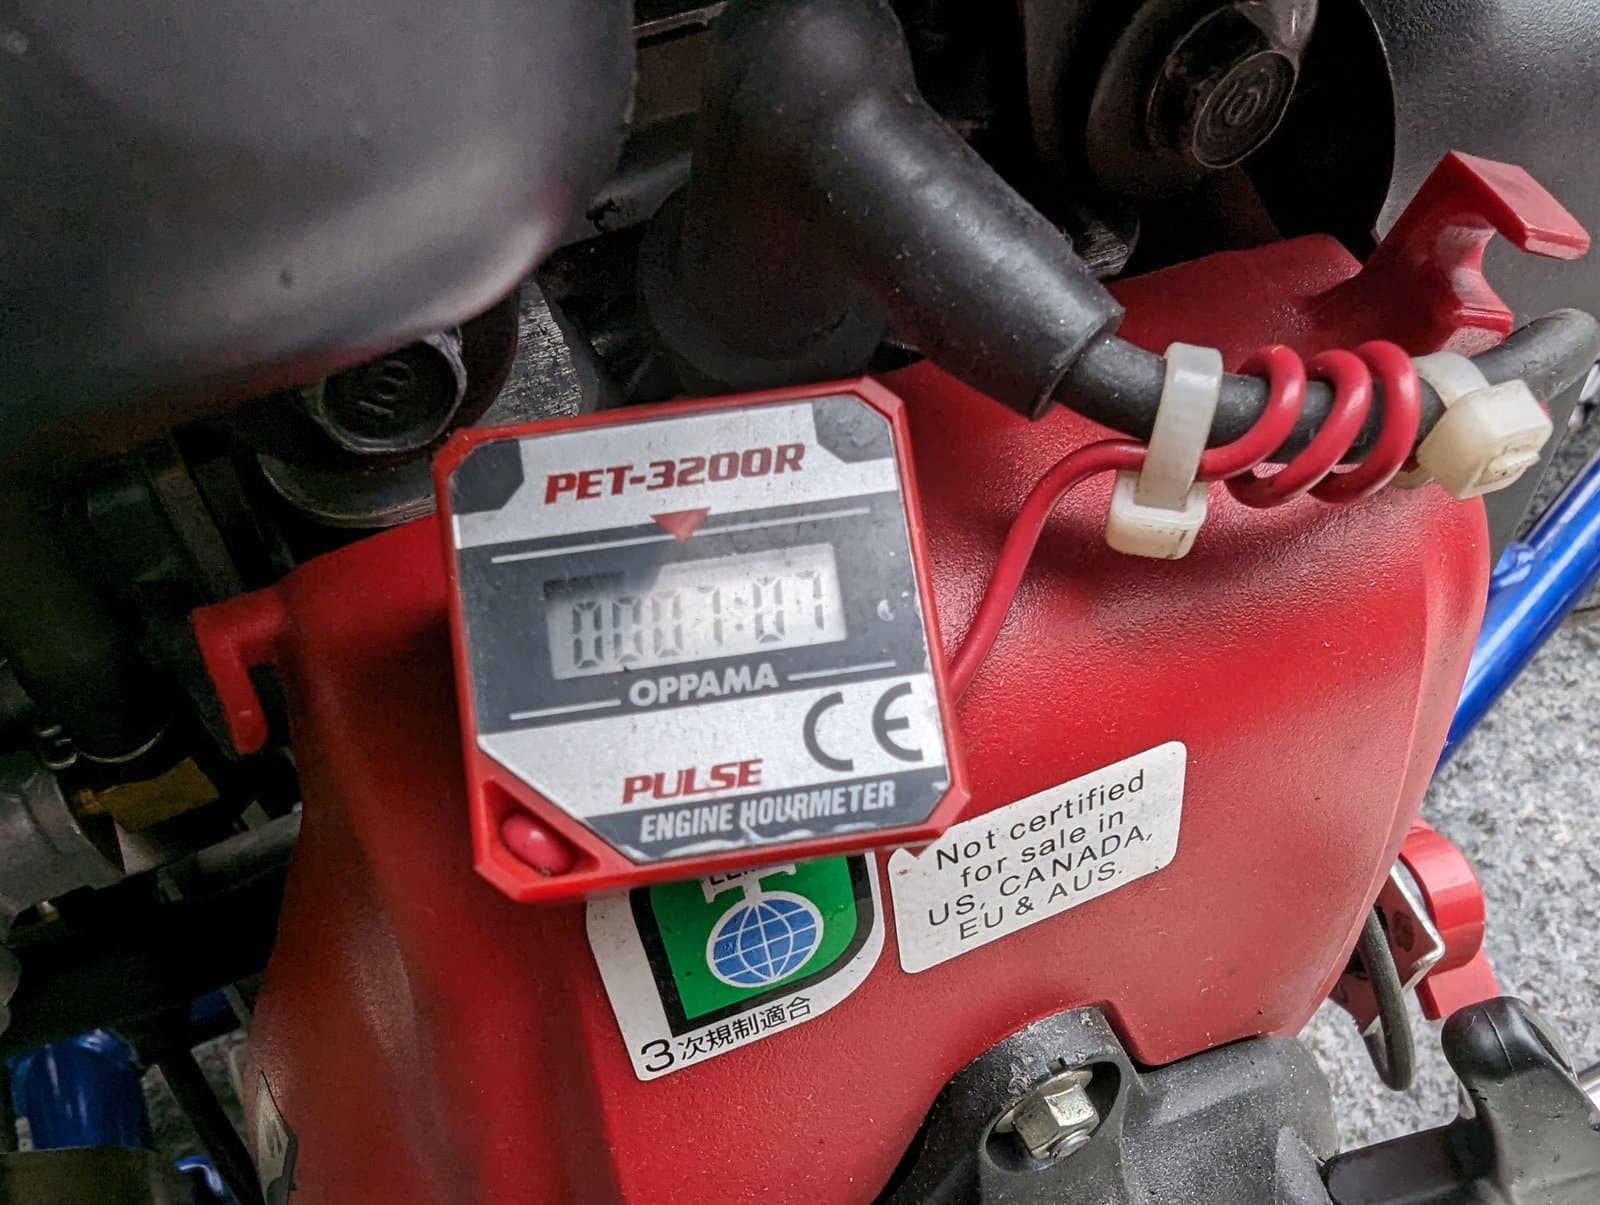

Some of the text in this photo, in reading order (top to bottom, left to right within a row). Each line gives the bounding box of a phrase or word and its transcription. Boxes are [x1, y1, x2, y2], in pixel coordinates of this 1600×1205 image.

[544, 443, 806, 504] PET-3200R
[628, 662, 778, 708] OPPAMA
[802, 682, 924, 771] CE
[622, 758, 763, 804] PULSE
[639, 780, 896, 844] ENGINE HOURMETER
[936, 770, 1145, 870] Not certified
[961, 809, 1125, 888] for sale in
[928, 825, 1153, 926] US, CANADA,
[958, 865, 1123, 941] EU & AUS.
[640, 995, 812, 1073] 3次規制適合
